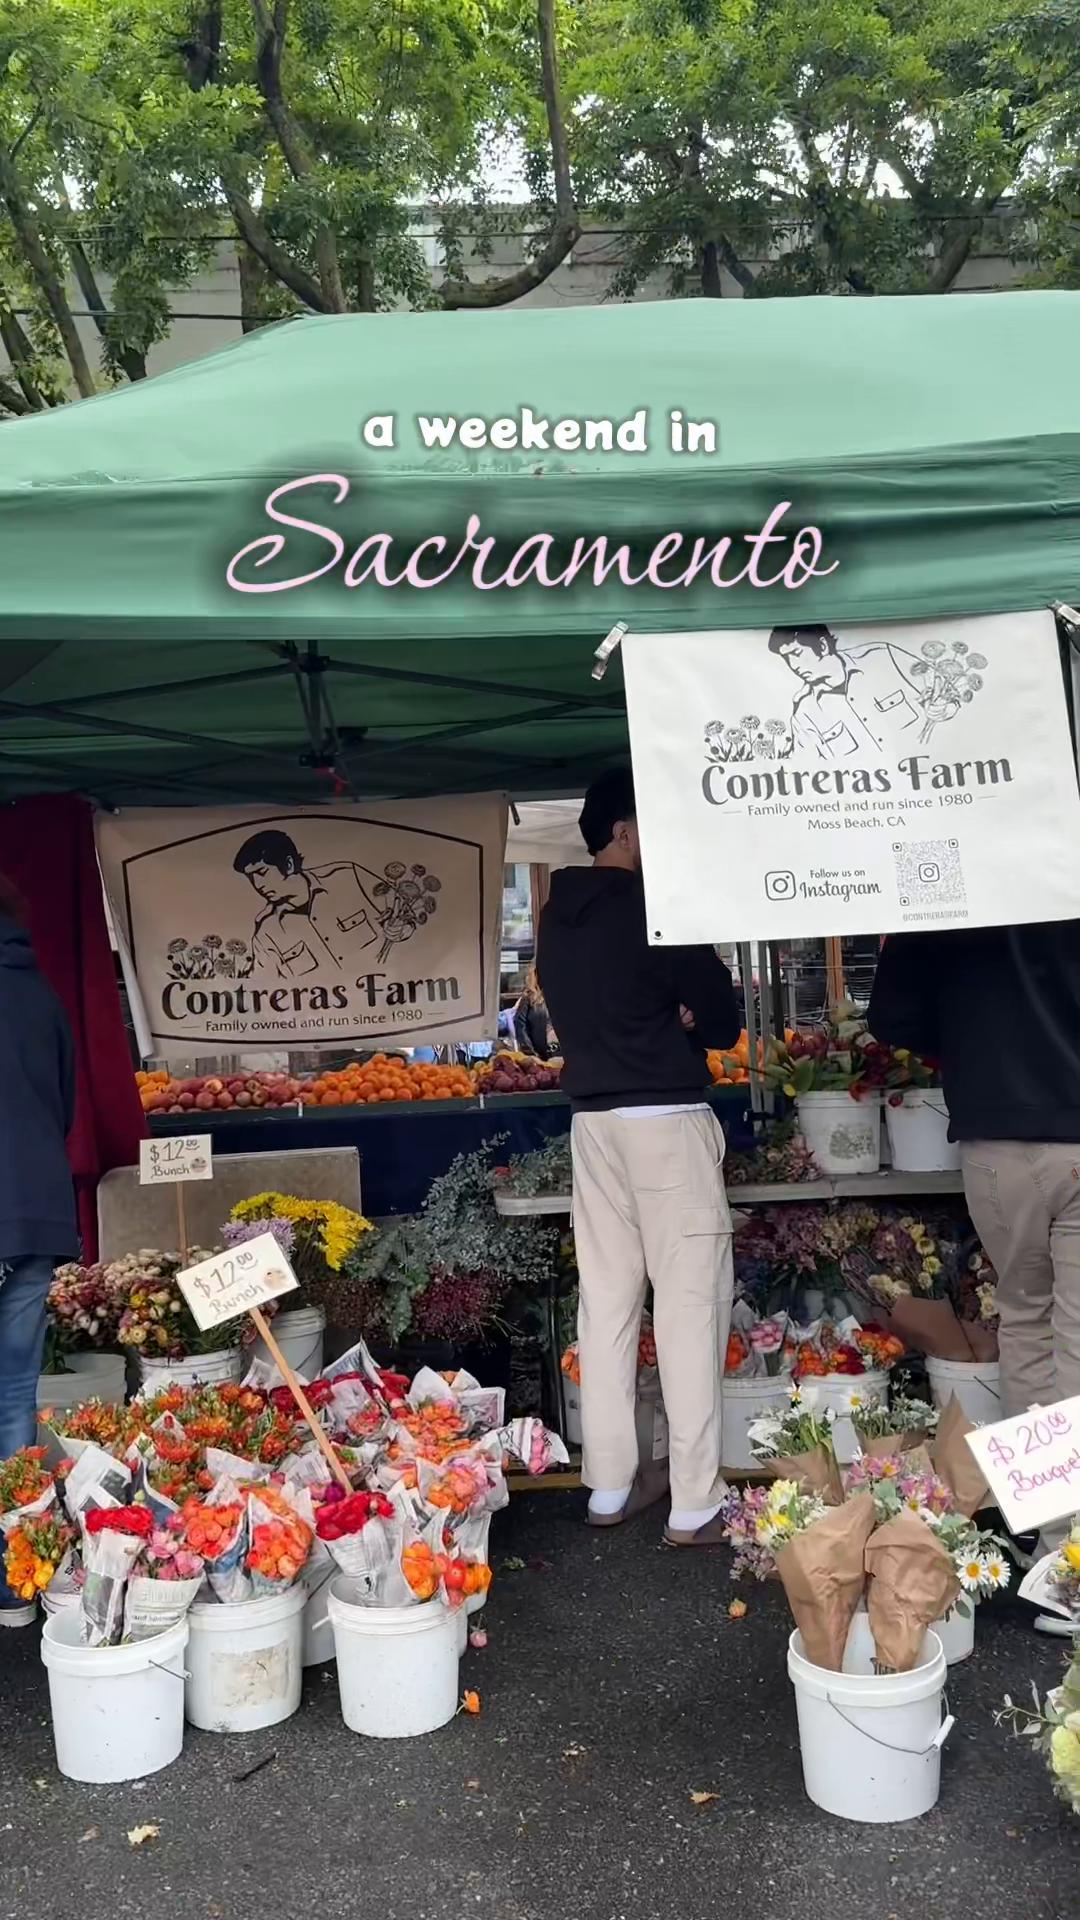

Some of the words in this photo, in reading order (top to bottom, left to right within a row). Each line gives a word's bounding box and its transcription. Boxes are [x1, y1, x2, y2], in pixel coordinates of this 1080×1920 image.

[702, 765, 891, 805] Contreras
[898, 755, 1015, 790] Farm
[748, 803, 790, 816] Family
[795, 801, 840, 813] owned
[844, 800, 868, 811] and
[872, 801, 894, 810] run
[899, 798, 932, 809] since
[939, 793, 973, 807] 1980
[808, 819, 841, 830] Moss
[887, 816, 906, 827] CA
[810, 868, 839, 879] Follow
[841, 870, 852, 878] us
[854, 869, 866, 877] on
[800, 880, 881, 902] Instagram
[162, 982, 348, 1020] Contreras
[356, 973, 461, 1007] Farm
[206, 1020, 248, 1033] Family
[251, 1018, 296, 1030] owned
[300, 1017, 324, 1028] and
[329, 1017, 349, 1026] run
[353, 1014, 386, 1024] since
[392, 1009, 422, 1021] 1980
[151, 1165, 190, 1179] Bunch
[209, 1282, 265, 1316] Bunch
